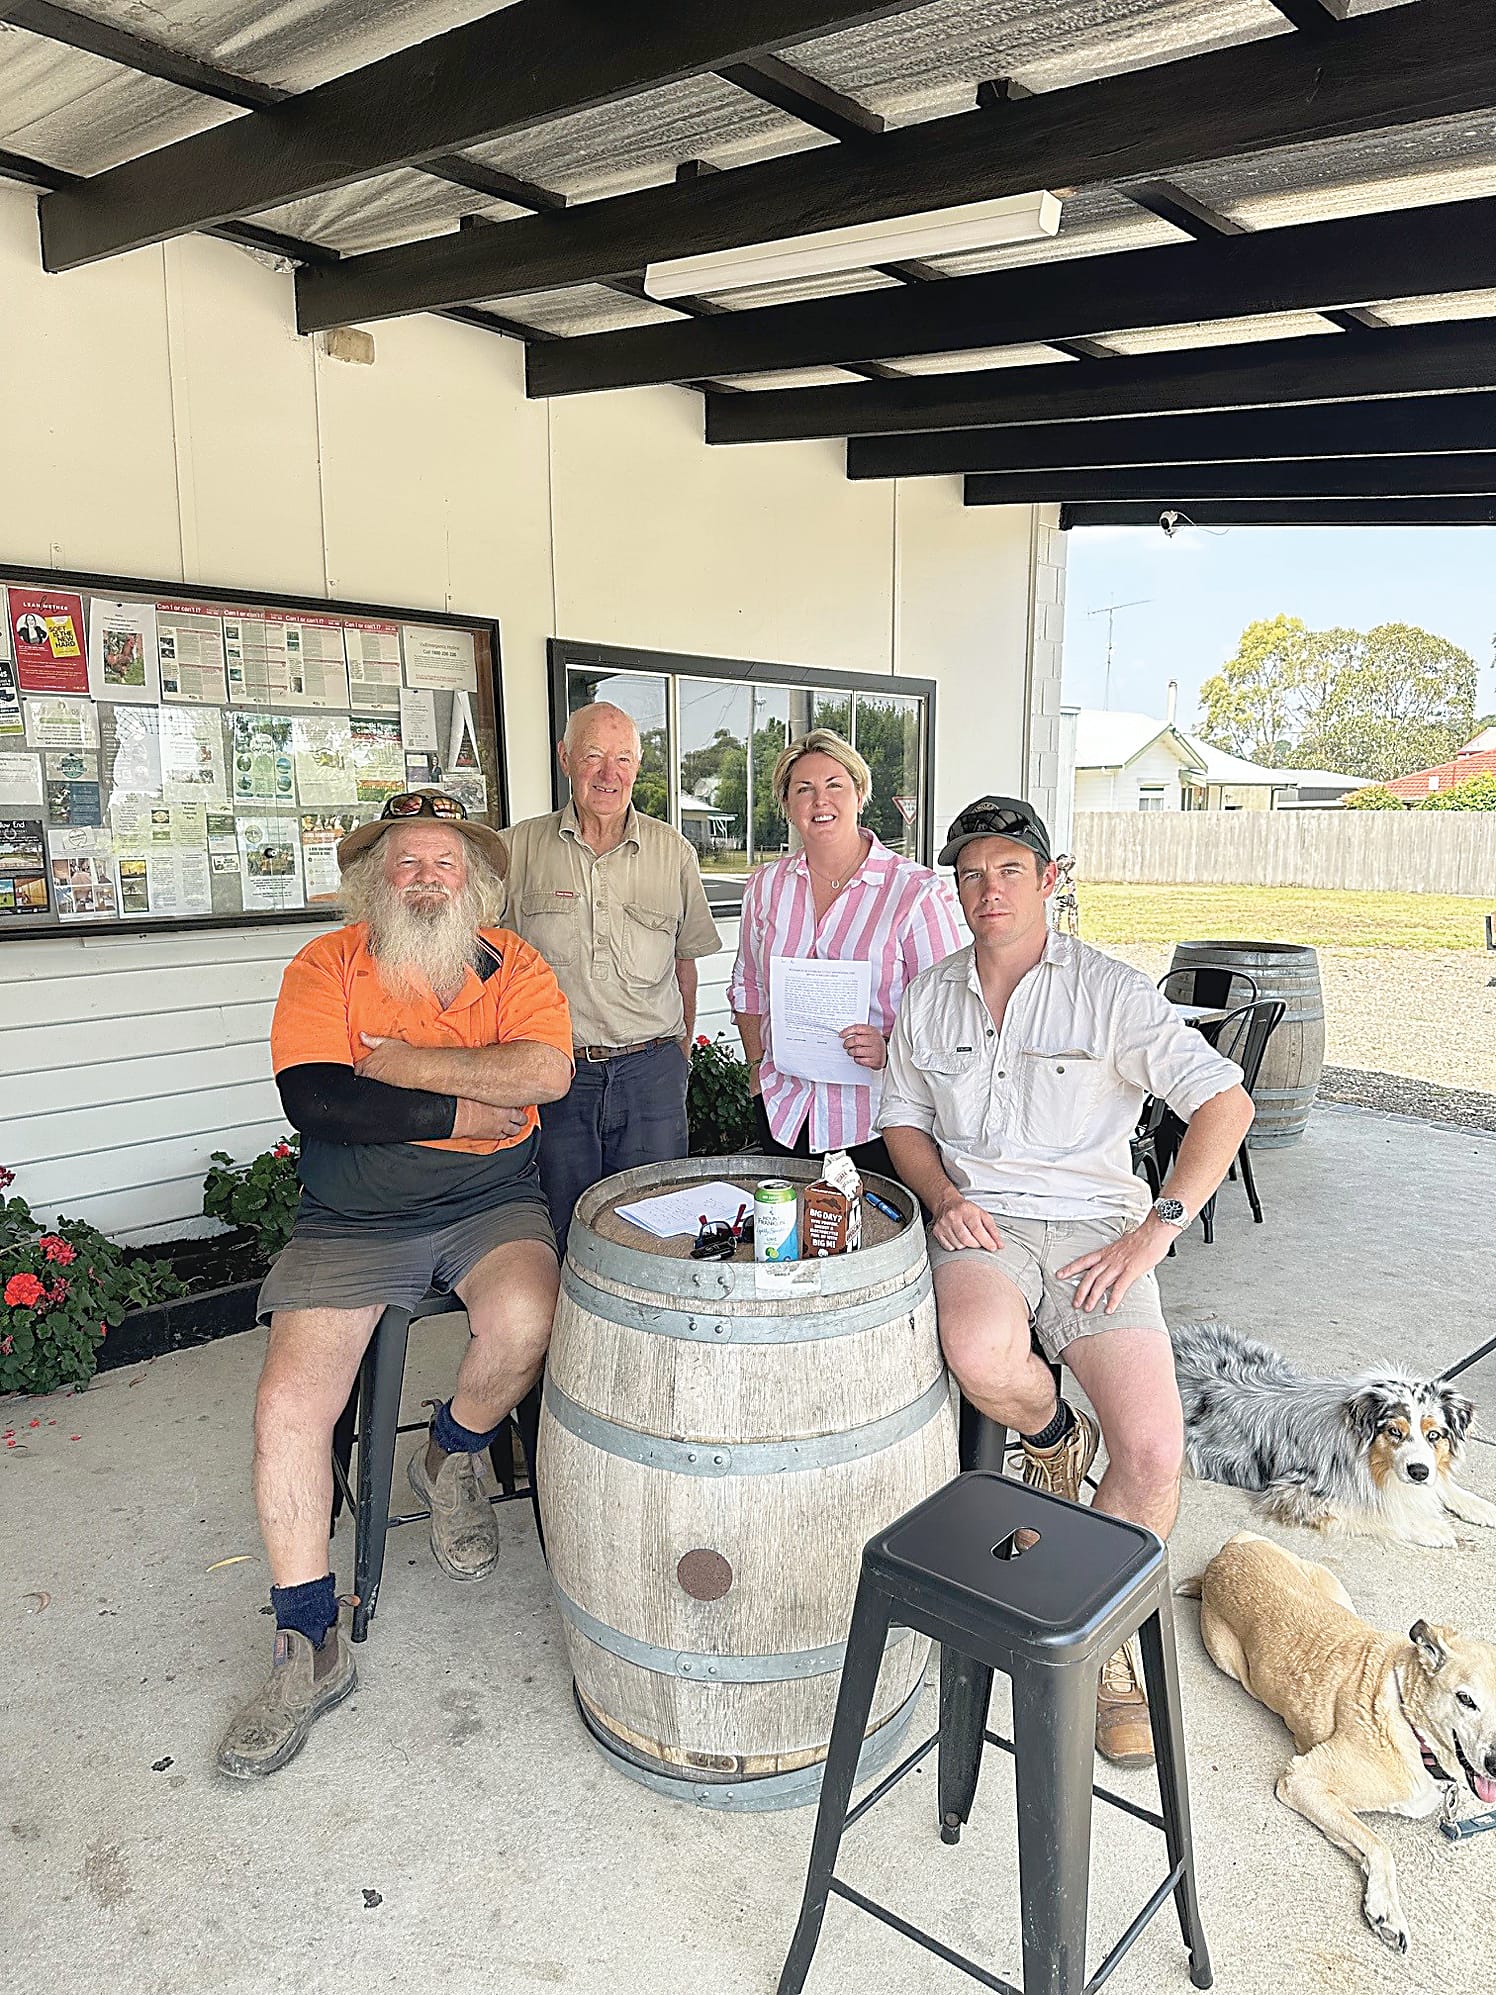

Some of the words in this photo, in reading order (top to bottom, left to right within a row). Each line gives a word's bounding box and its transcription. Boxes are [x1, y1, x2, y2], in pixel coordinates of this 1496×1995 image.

[810, 1209, 822, 1218] BIG
[823, 1212, 842, 1222] DAY?
[812, 1239, 826, 1247] BIG
[826, 1240, 836, 1249] M!
